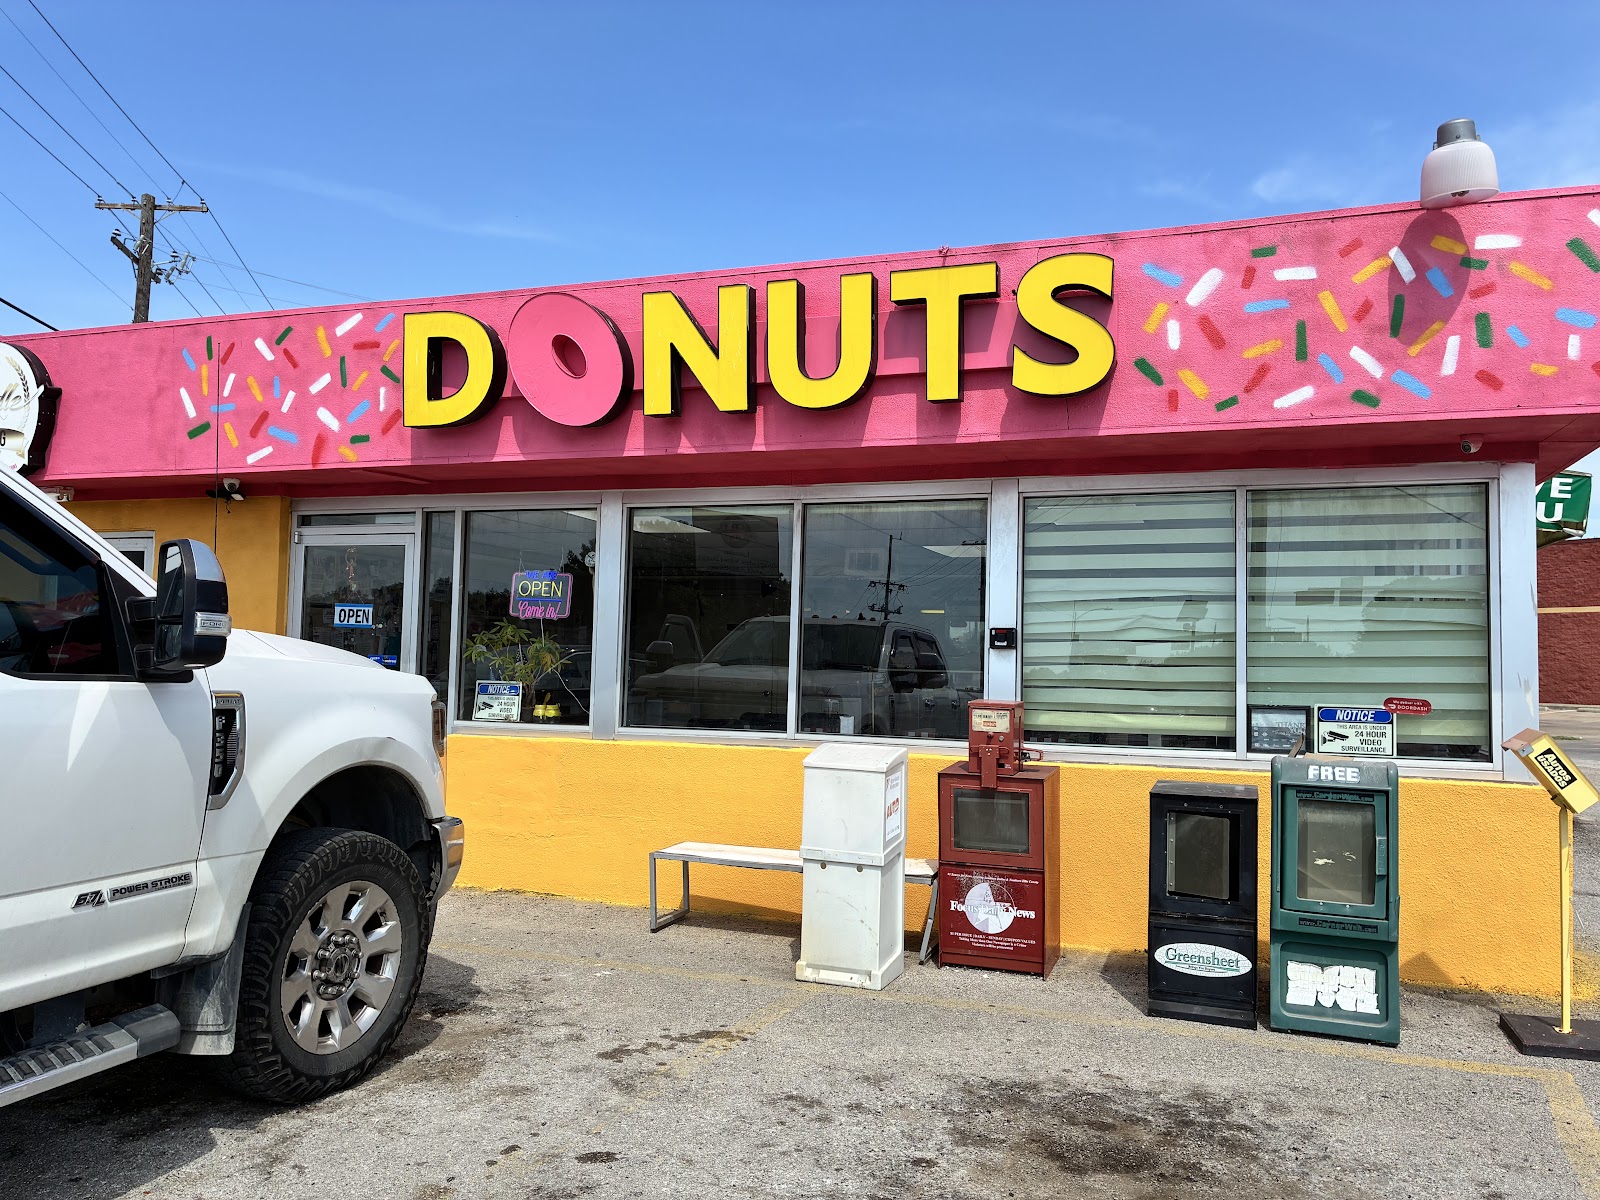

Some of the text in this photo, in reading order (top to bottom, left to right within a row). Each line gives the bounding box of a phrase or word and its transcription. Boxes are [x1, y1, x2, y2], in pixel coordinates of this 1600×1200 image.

[403, 252, 1116, 428] DONUTS
[1535, 477, 1574, 499] E
[525, 570, 558, 580] WE ARE
[518, 580, 563, 597] OPEN
[338, 608, 370, 624] OPEN
[518, 600, 545, 619] Come
[487, 685, 511, 694] NOTICE
[1335, 709, 1375, 722] NOTICE
[1354, 730, 1387, 739] 24 HOUR
[1359, 738, 1382, 746] VIDEO
[1340, 745, 1387, 753] SURVEILLANCE
[1308, 765, 1360, 782] FREE
[1536, 755, 1568, 788] USADOS
[1543, 753, 1573, 783] AUTOS
[112, 873, 191, 896] POWER STROKE
[950, 900, 1036, 919] Focus Daily News
[1164, 947, 1241, 968] Greensheet
